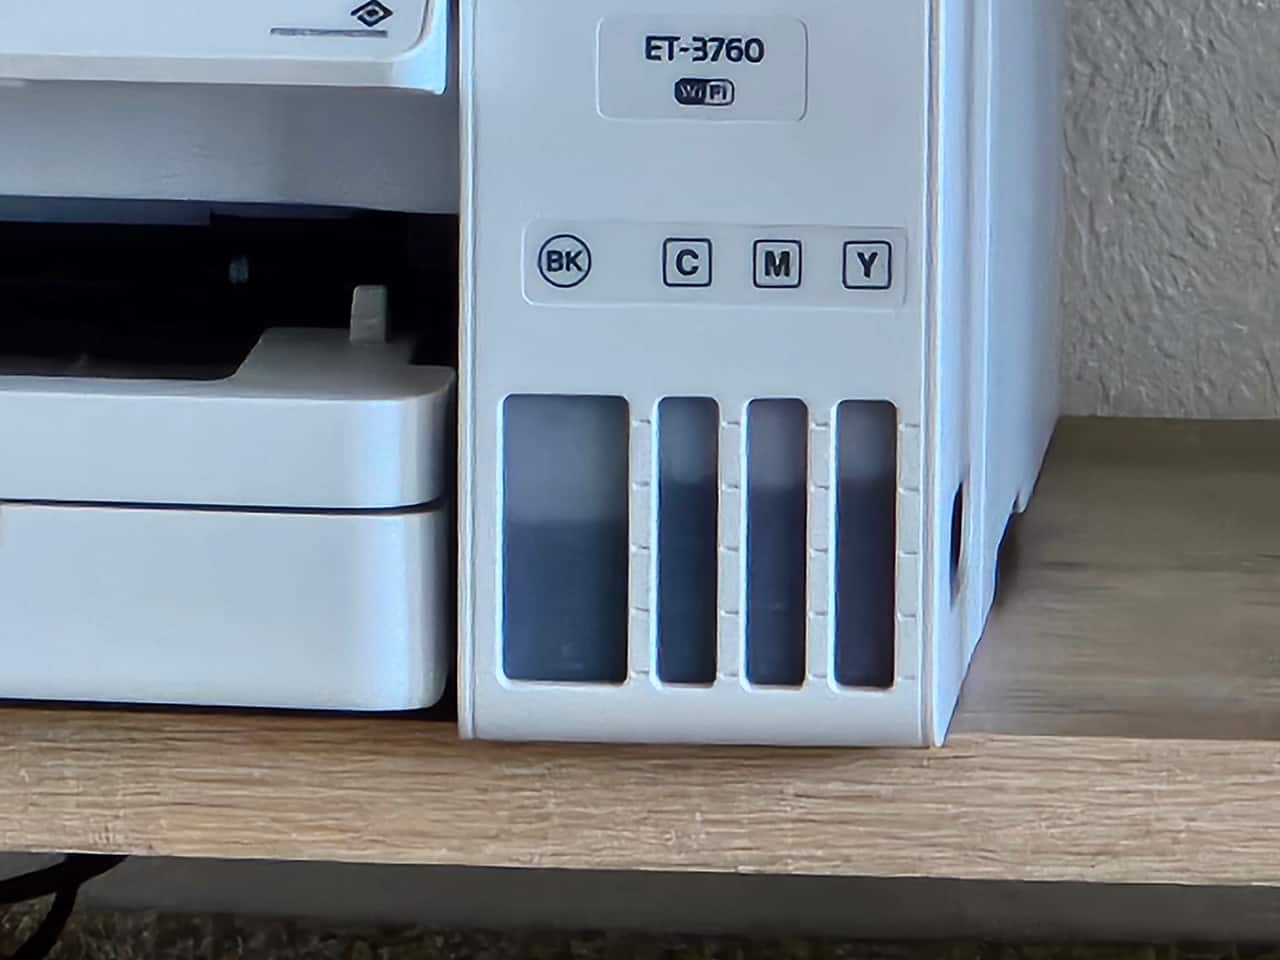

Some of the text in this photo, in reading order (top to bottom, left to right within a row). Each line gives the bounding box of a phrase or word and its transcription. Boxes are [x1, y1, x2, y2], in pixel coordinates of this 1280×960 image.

[644, 35, 765, 63] ET-3760
[546, 248, 880, 278] BK C M Y
